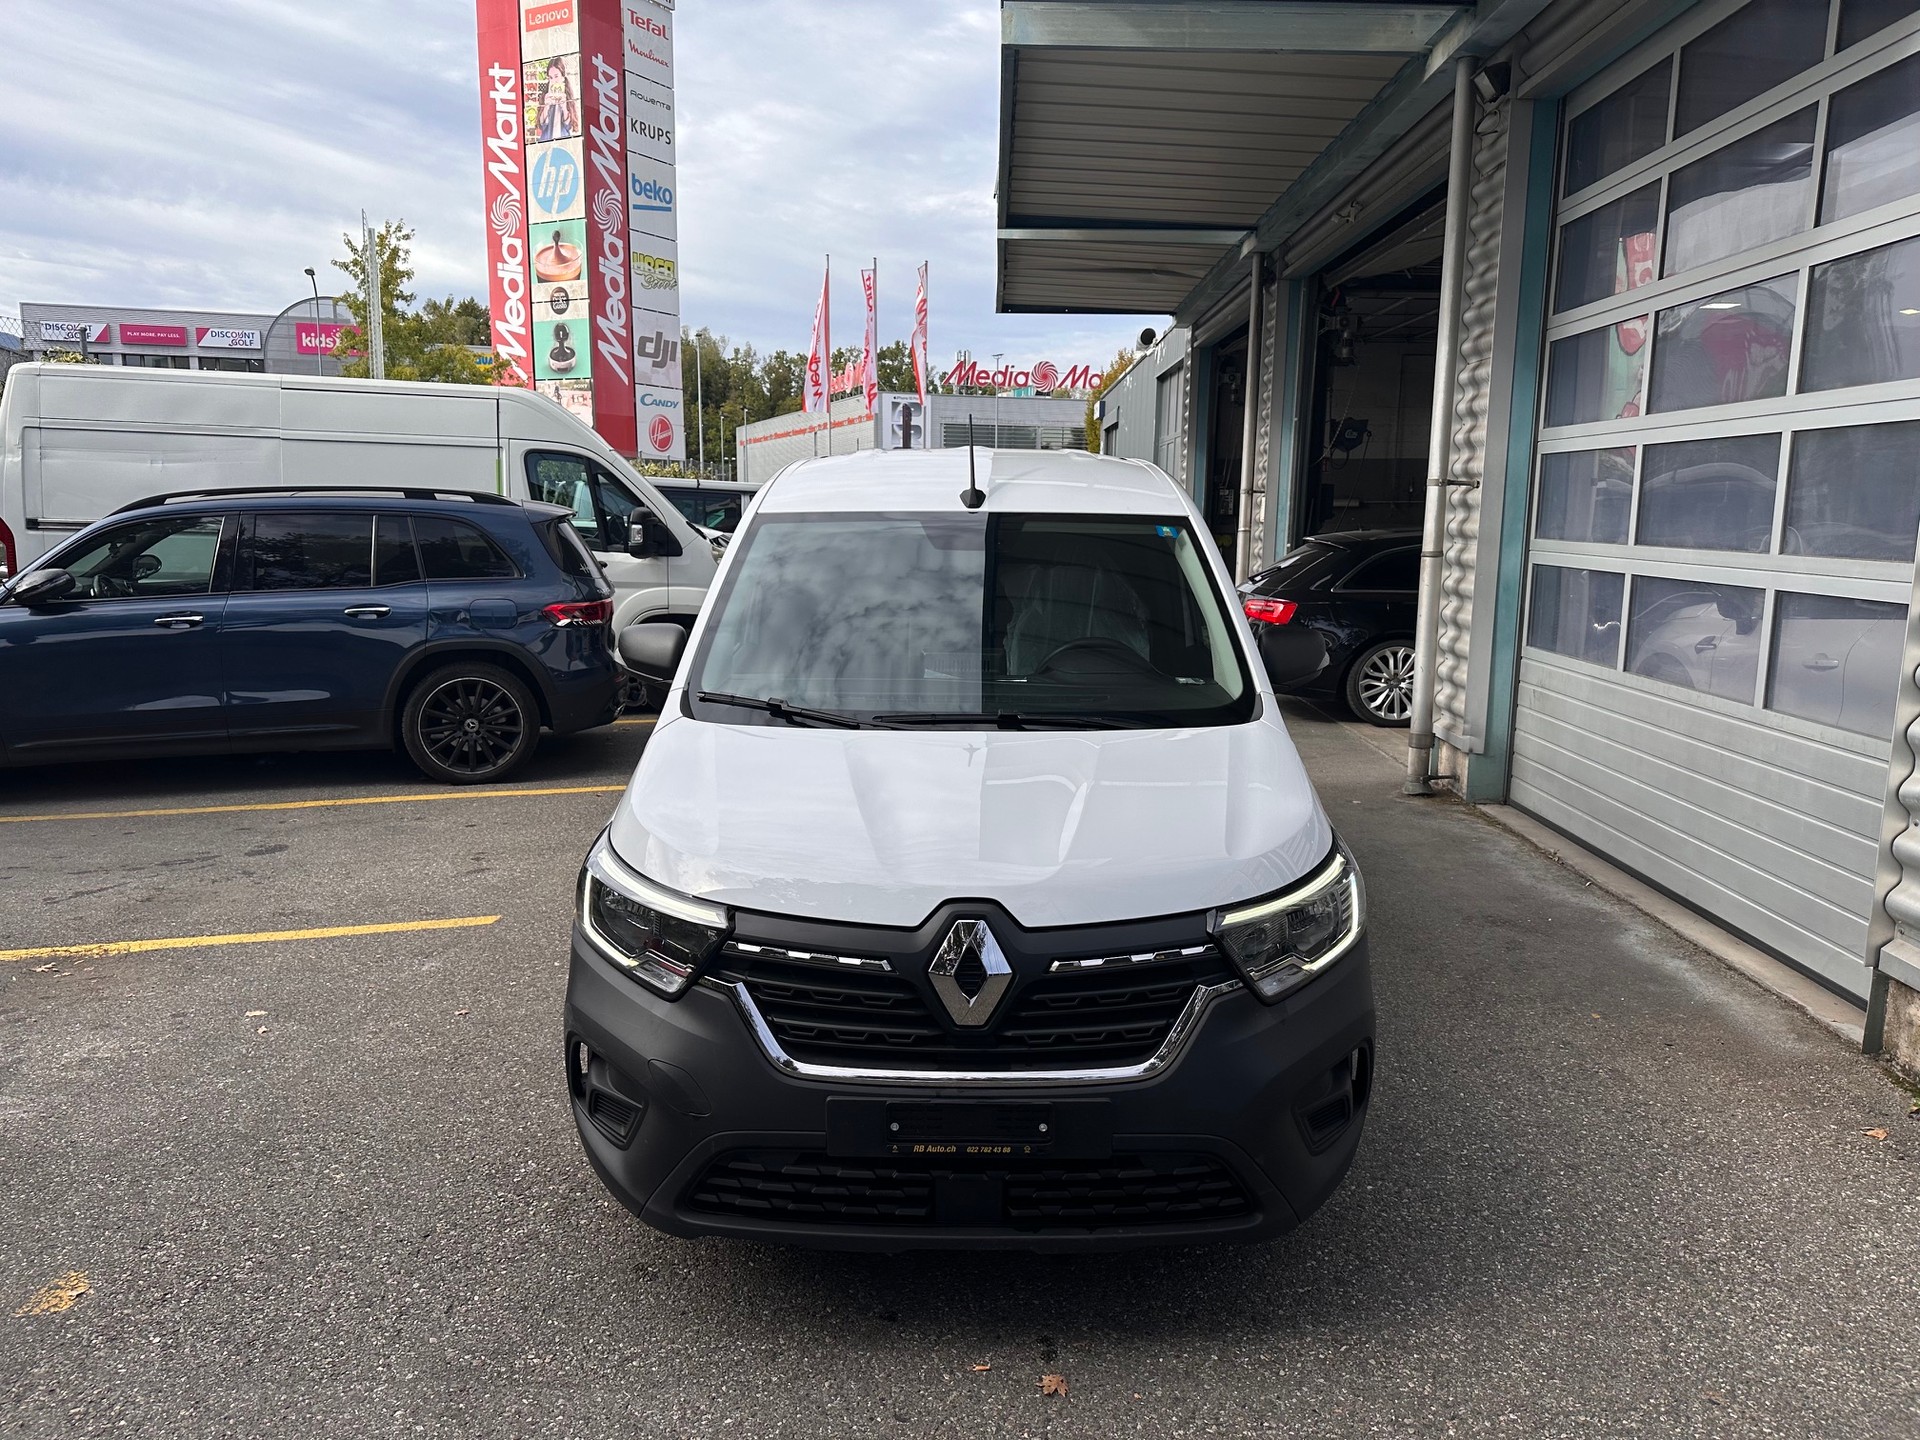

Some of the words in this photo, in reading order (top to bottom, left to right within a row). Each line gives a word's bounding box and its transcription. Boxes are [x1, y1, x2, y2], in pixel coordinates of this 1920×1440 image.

[529, 8, 569, 26] Lenovo
[627, 8, 669, 41] Tefal
[627, 38, 670, 68] Moulinex
[487, 62, 520, 200] Markt
[589, 53, 622, 201] Markt
[630, 118, 672, 145] KRUPS
[537, 148, 575, 219] hp
[631, 173, 673, 205] beko
[495, 235, 529, 384] Media
[597, 230, 629, 386] Media
[45, 323, 93, 332] DISCOUT
[66, 331, 91, 340] GOF
[210, 330, 255, 340] DISCOUNT
[229, 338, 254, 347] GOLF
[943, 360, 1031, 388] Media
[913, 1145, 924, 1153] RB
[926, 1144, 957, 1153] Auto.ch
